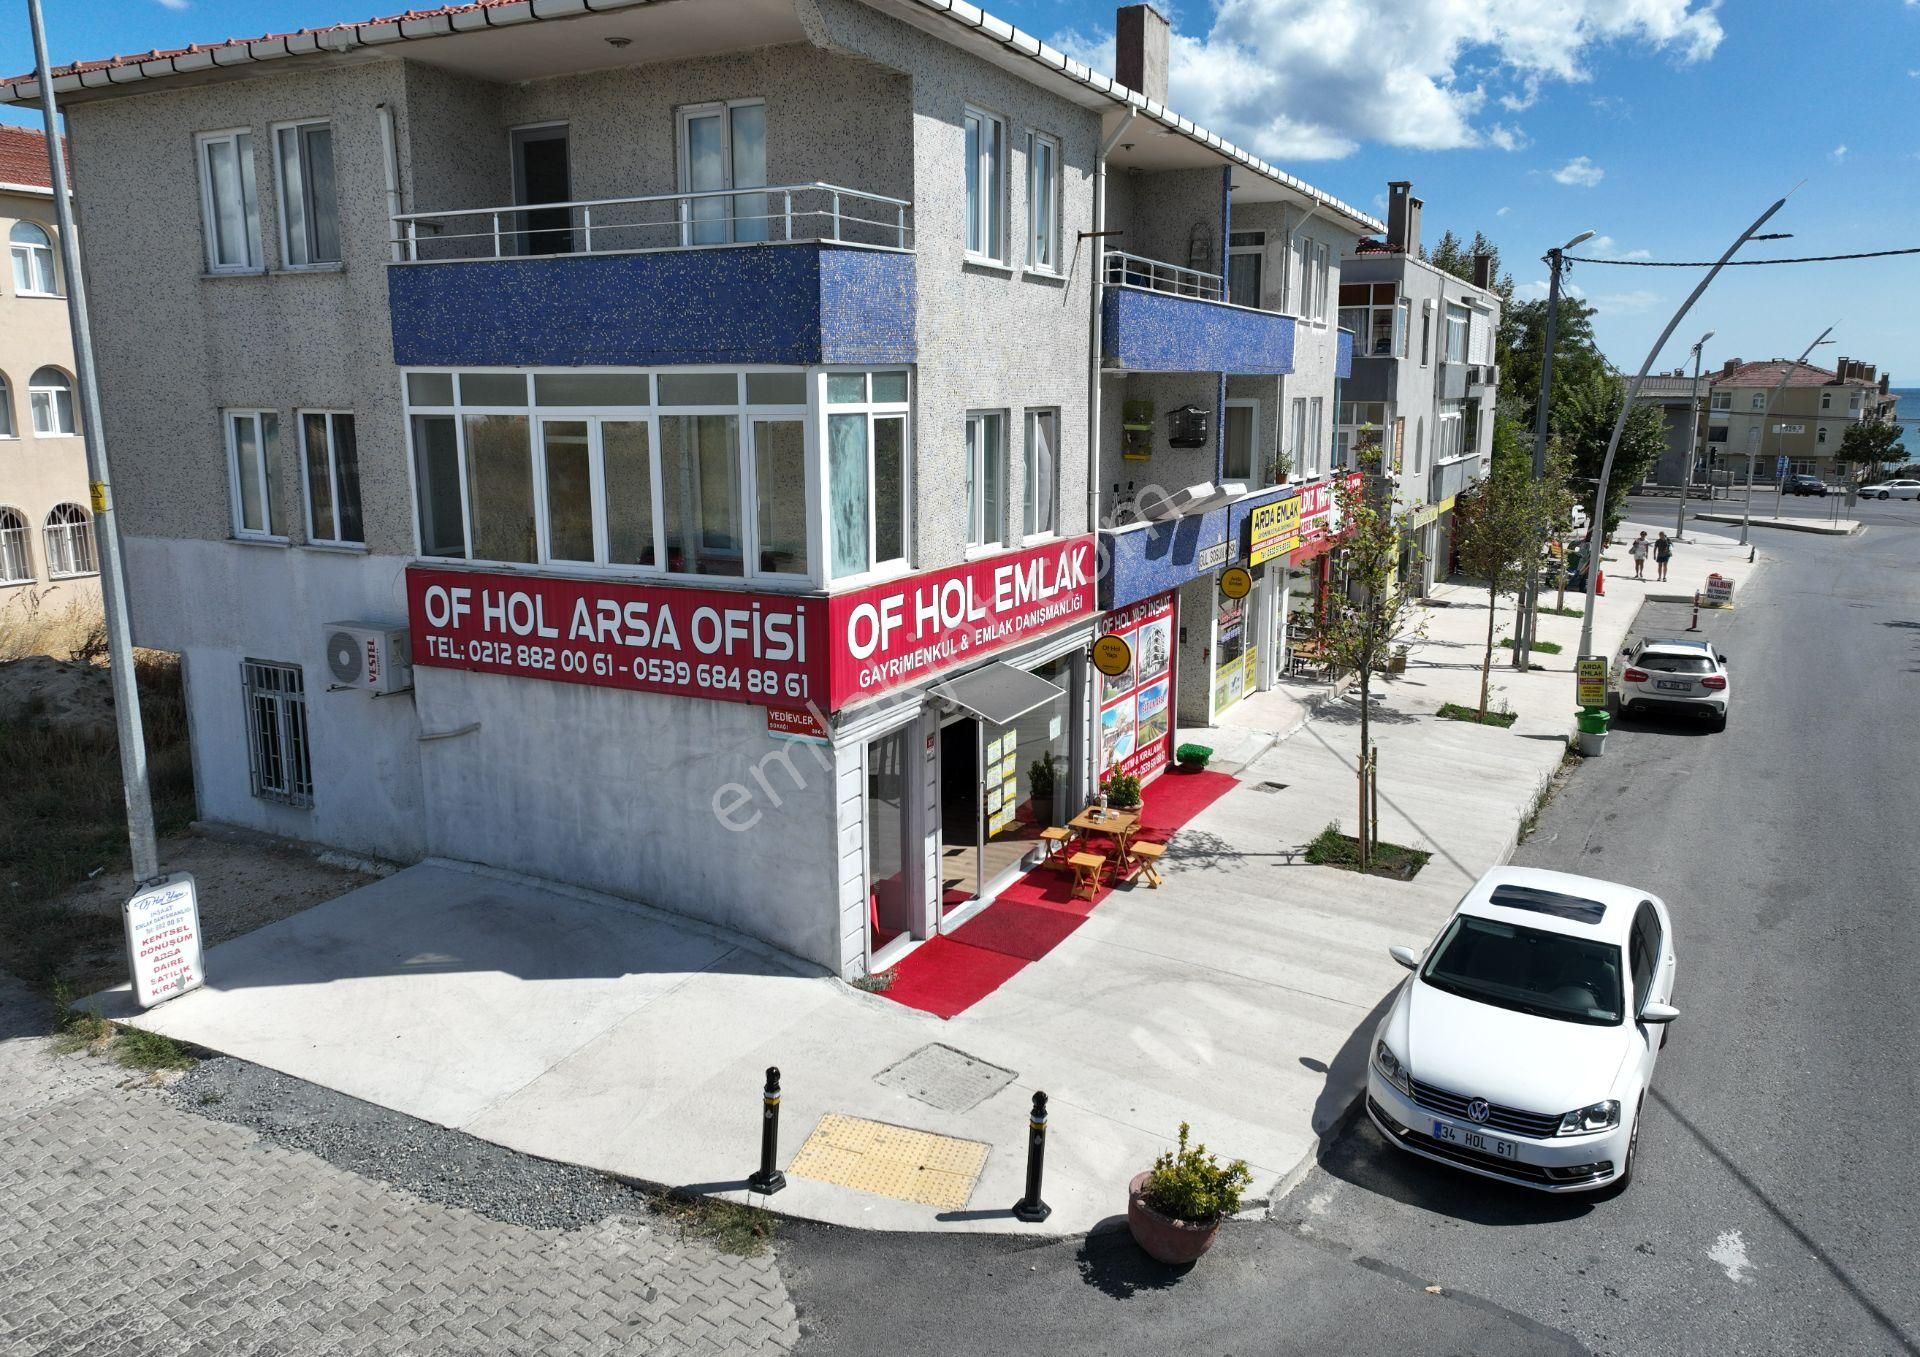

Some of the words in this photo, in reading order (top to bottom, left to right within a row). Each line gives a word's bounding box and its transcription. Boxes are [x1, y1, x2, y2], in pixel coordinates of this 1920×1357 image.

[1254, 508, 1275, 531] ARDA
[1276, 501, 1298, 524] EMLAK
[847, 593, 905, 660] OF
[915, 575, 986, 639] HOL
[994, 545, 1088, 613] EMLAK
[425, 585, 472, 629] OF
[482, 589, 559, 639] HOL
[568, 597, 682, 651] ARSA
[691, 602, 807, 663] OFİSİ
[960, 634, 969, 650] &
[975, 619, 1013, 646] EMLAK
[1015, 594, 1083, 631] DANIŞMANLIĞI
[1102, 617, 1113, 635] OF
[1115, 612, 1131, 630] HOL
[367, 637, 377, 683] VESTEL
[426, 636, 465, 660] TEL:
[469, 640, 512, 665] 0212
[517, 645, 556, 669] 882
[561, 650, 588, 673] 00
[593, 653, 613, 676] 61
[633, 656, 691, 685] 0539
[696, 664, 742, 691] 684
[747, 669, 779, 696] 88
[784, 673, 809, 698] 61
[142, 925, 190, 946] KENTSEL
[153, 947, 181, 962] ARSA
[150, 965, 190, 985] SATILIK
[1441, 1126, 1456, 1141] 34
[1465, 1132, 1487, 1150] HOL
[1497, 1142, 1512, 1156] 61
